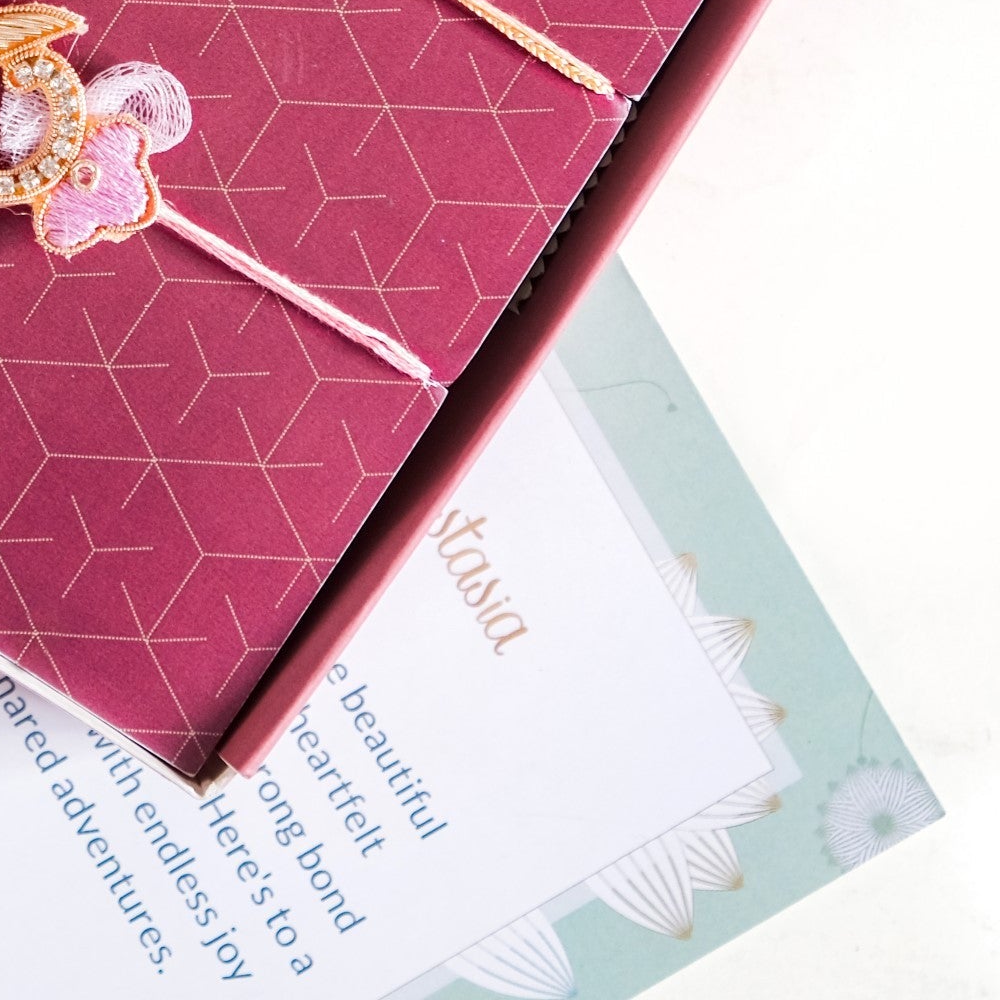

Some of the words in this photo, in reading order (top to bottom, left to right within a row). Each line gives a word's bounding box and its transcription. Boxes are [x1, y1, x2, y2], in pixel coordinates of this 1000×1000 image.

[290, 704, 386, 859] heartfelt
[339, 684, 448, 840] beautiful
[51, 778, 172, 975] adventures.
[134, 802, 219, 927] endless
[200, 926, 253, 981] joy
[199, 793, 275, 906] Here's
[266, 907, 298, 947] to
[290, 953, 313, 976] a
[296, 843, 367, 933] bond
